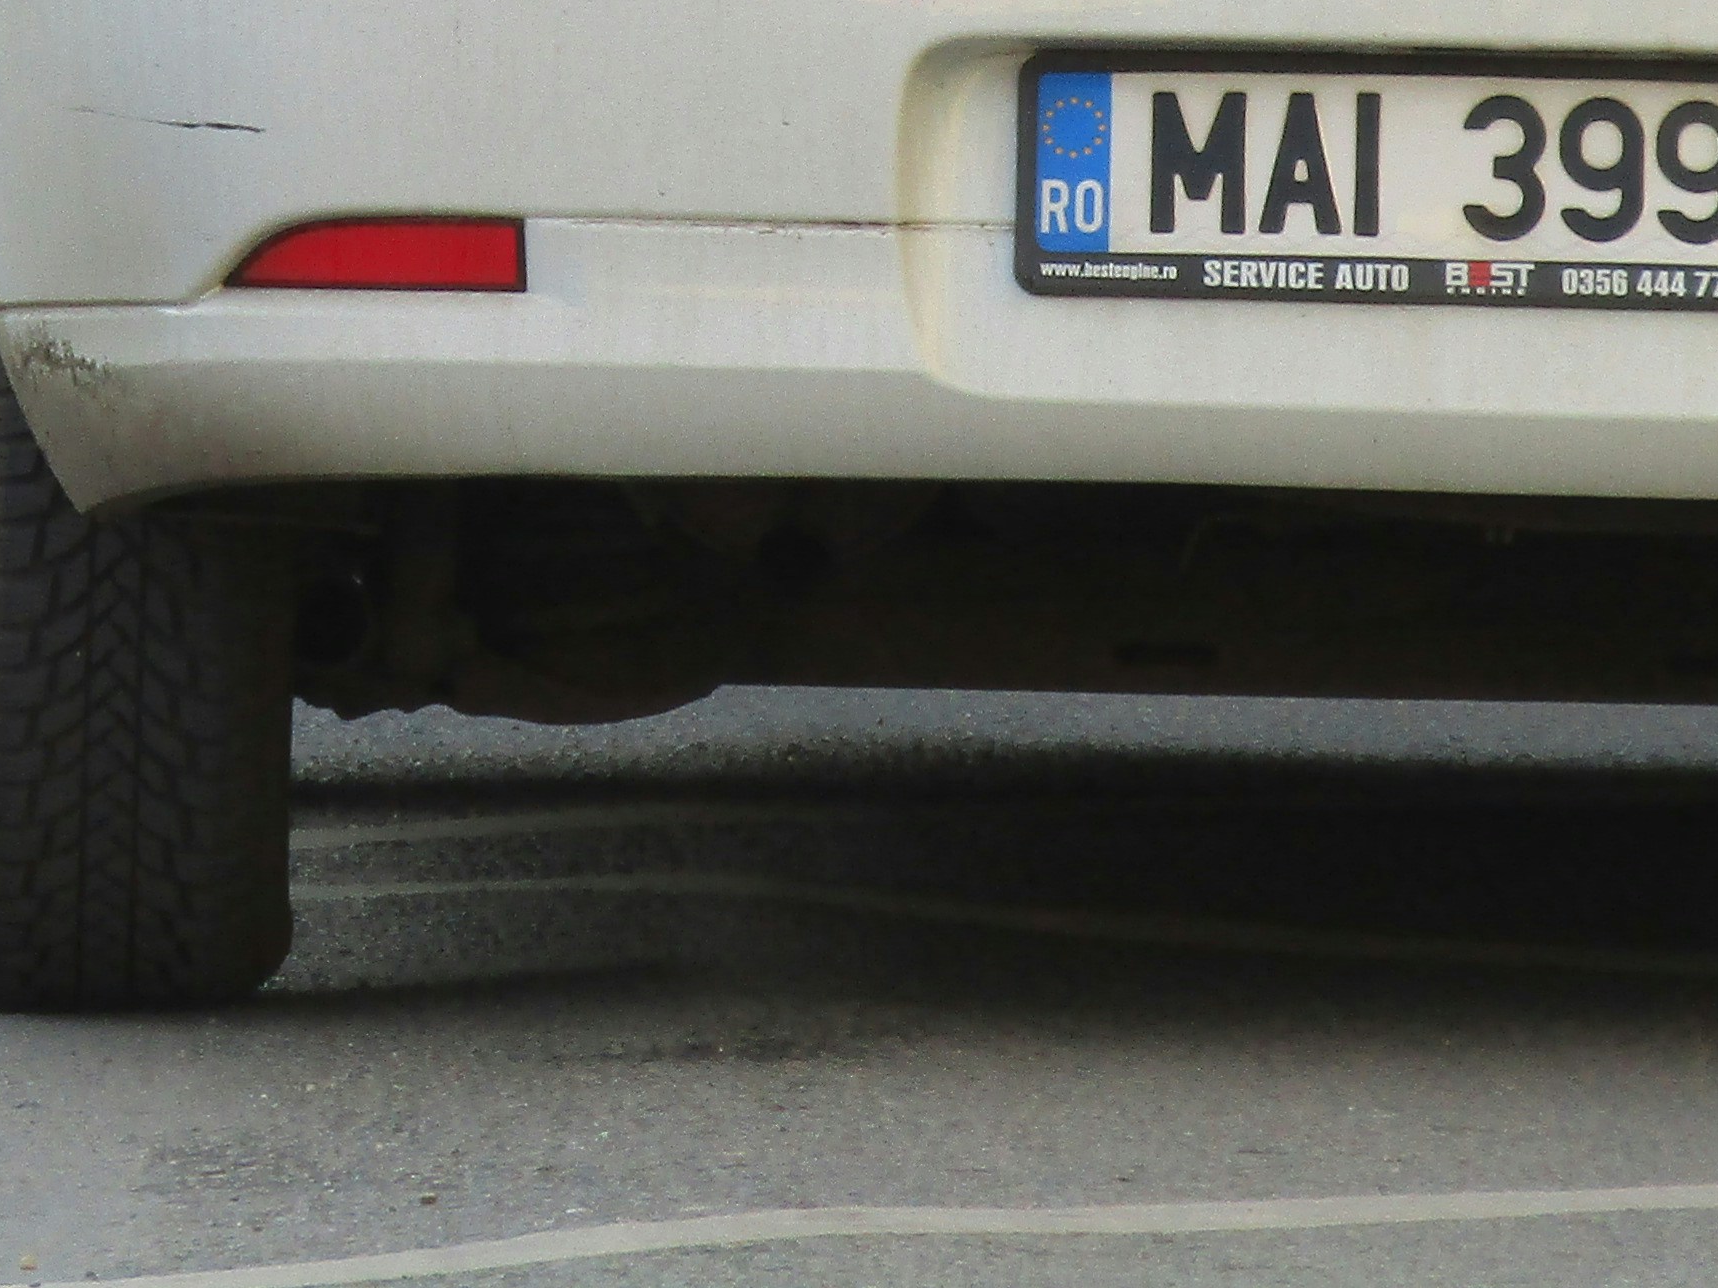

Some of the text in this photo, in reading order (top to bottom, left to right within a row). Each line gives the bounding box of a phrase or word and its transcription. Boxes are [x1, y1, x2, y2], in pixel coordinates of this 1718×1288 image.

[1149, 91, 1381, 236] MAI
[1039, 179, 1104, 234] RO
[1202, 260, 1411, 292] SERVICE AUTO
[1561, 268, 1629, 296] 0356
[1635, 270, 1686, 297] 444
